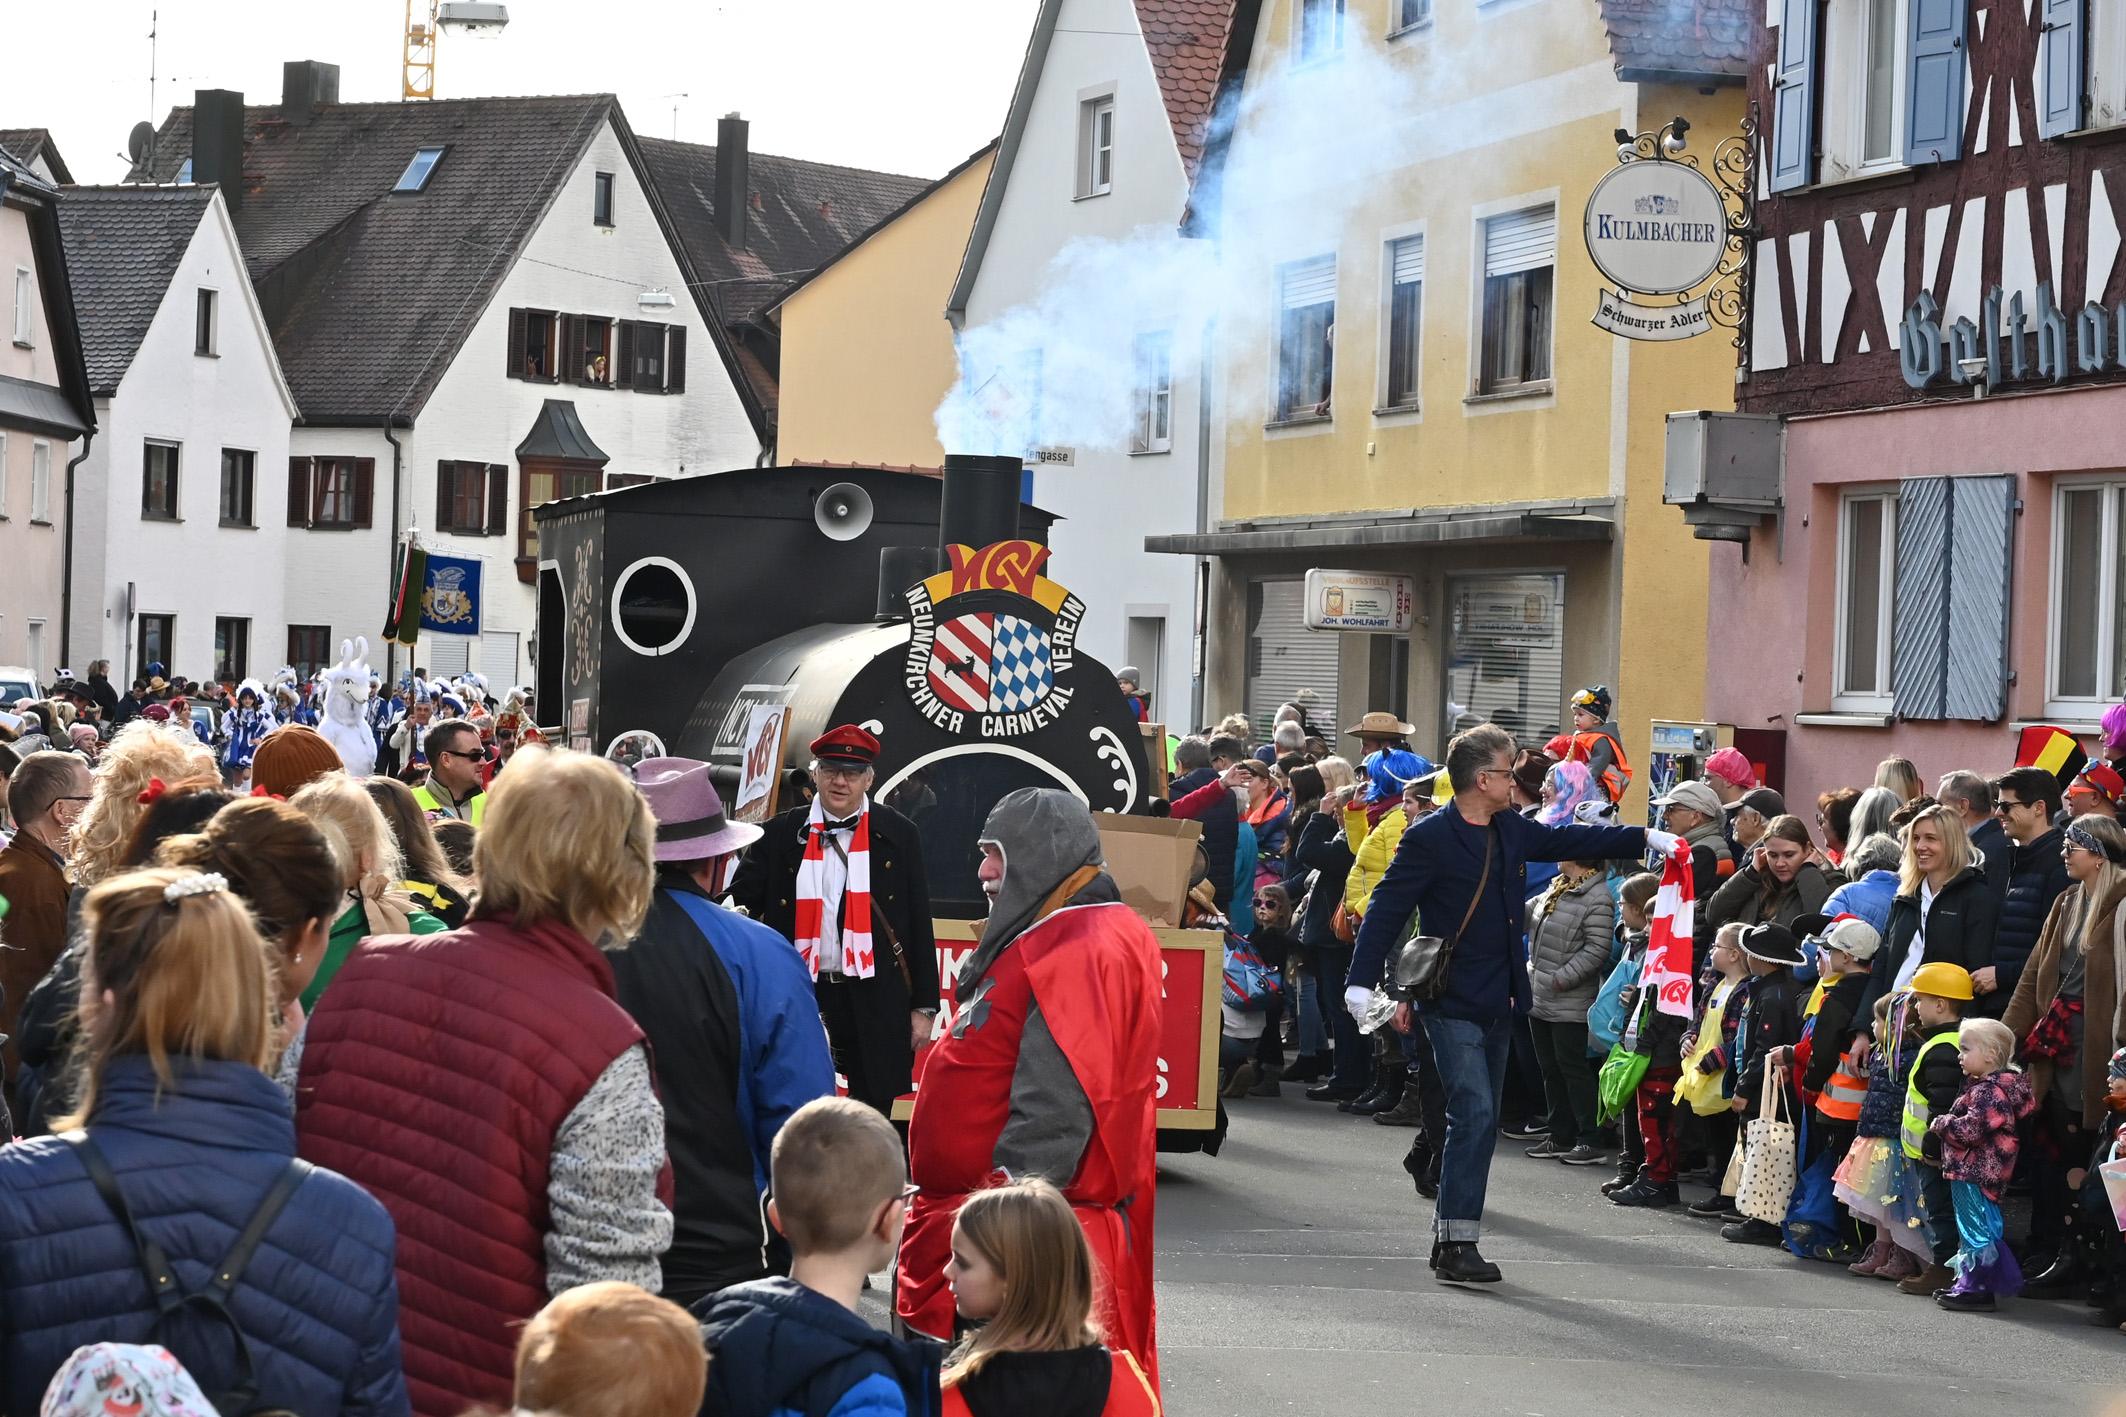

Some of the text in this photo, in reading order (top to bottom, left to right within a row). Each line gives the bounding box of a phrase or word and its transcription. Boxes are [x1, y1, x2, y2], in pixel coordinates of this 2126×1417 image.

[1597, 214, 1716, 243] KULMBACHER
[1601, 303, 1704, 332] Schwarzer Adler
[1321, 617, 1390, 627] JOH. WOHLFAHRT
[905, 586, 1086, 737] NEUNKIRCHNER CARNEVAL VEREIN
